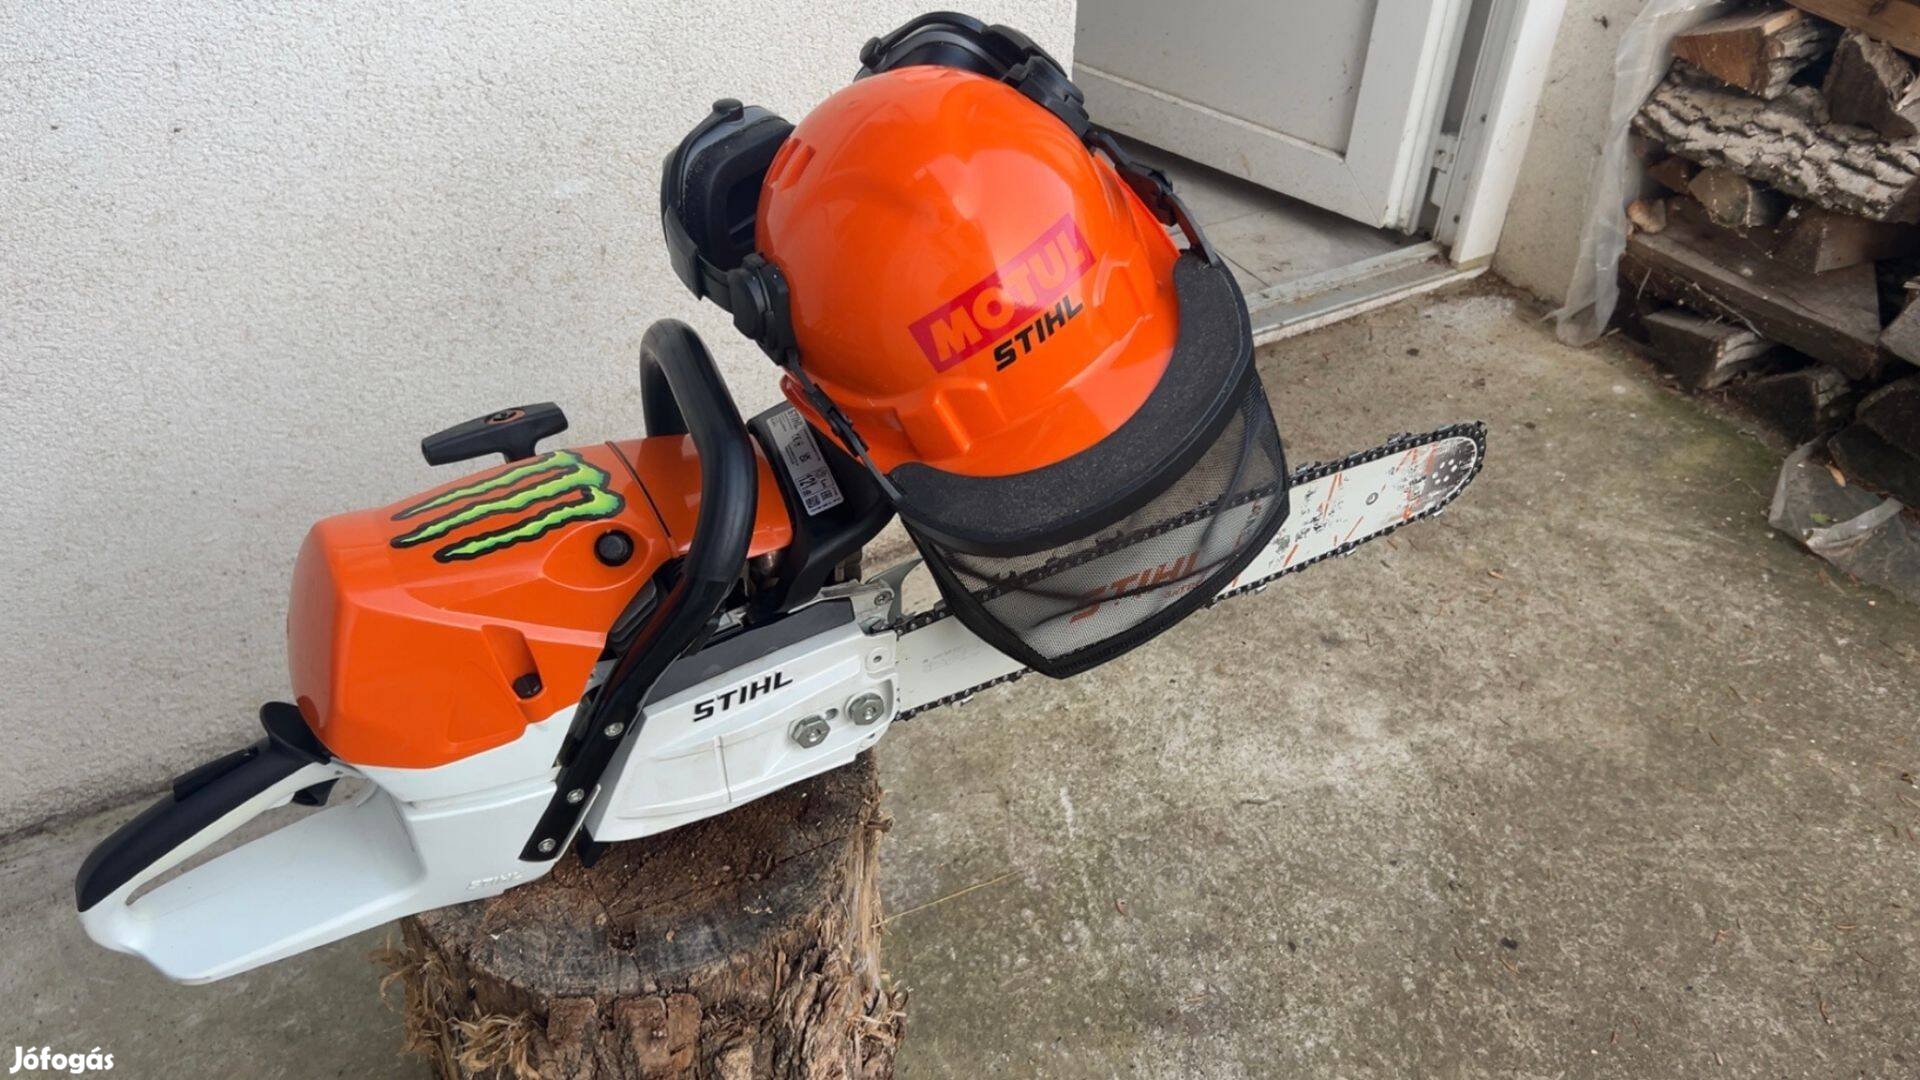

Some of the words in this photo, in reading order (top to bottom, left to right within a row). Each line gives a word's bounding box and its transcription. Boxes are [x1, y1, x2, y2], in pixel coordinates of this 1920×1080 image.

[929, 230, 1086, 363] MOTUL
[993, 295, 1083, 372] STIHL
[693, 672, 793, 722] STIHL
